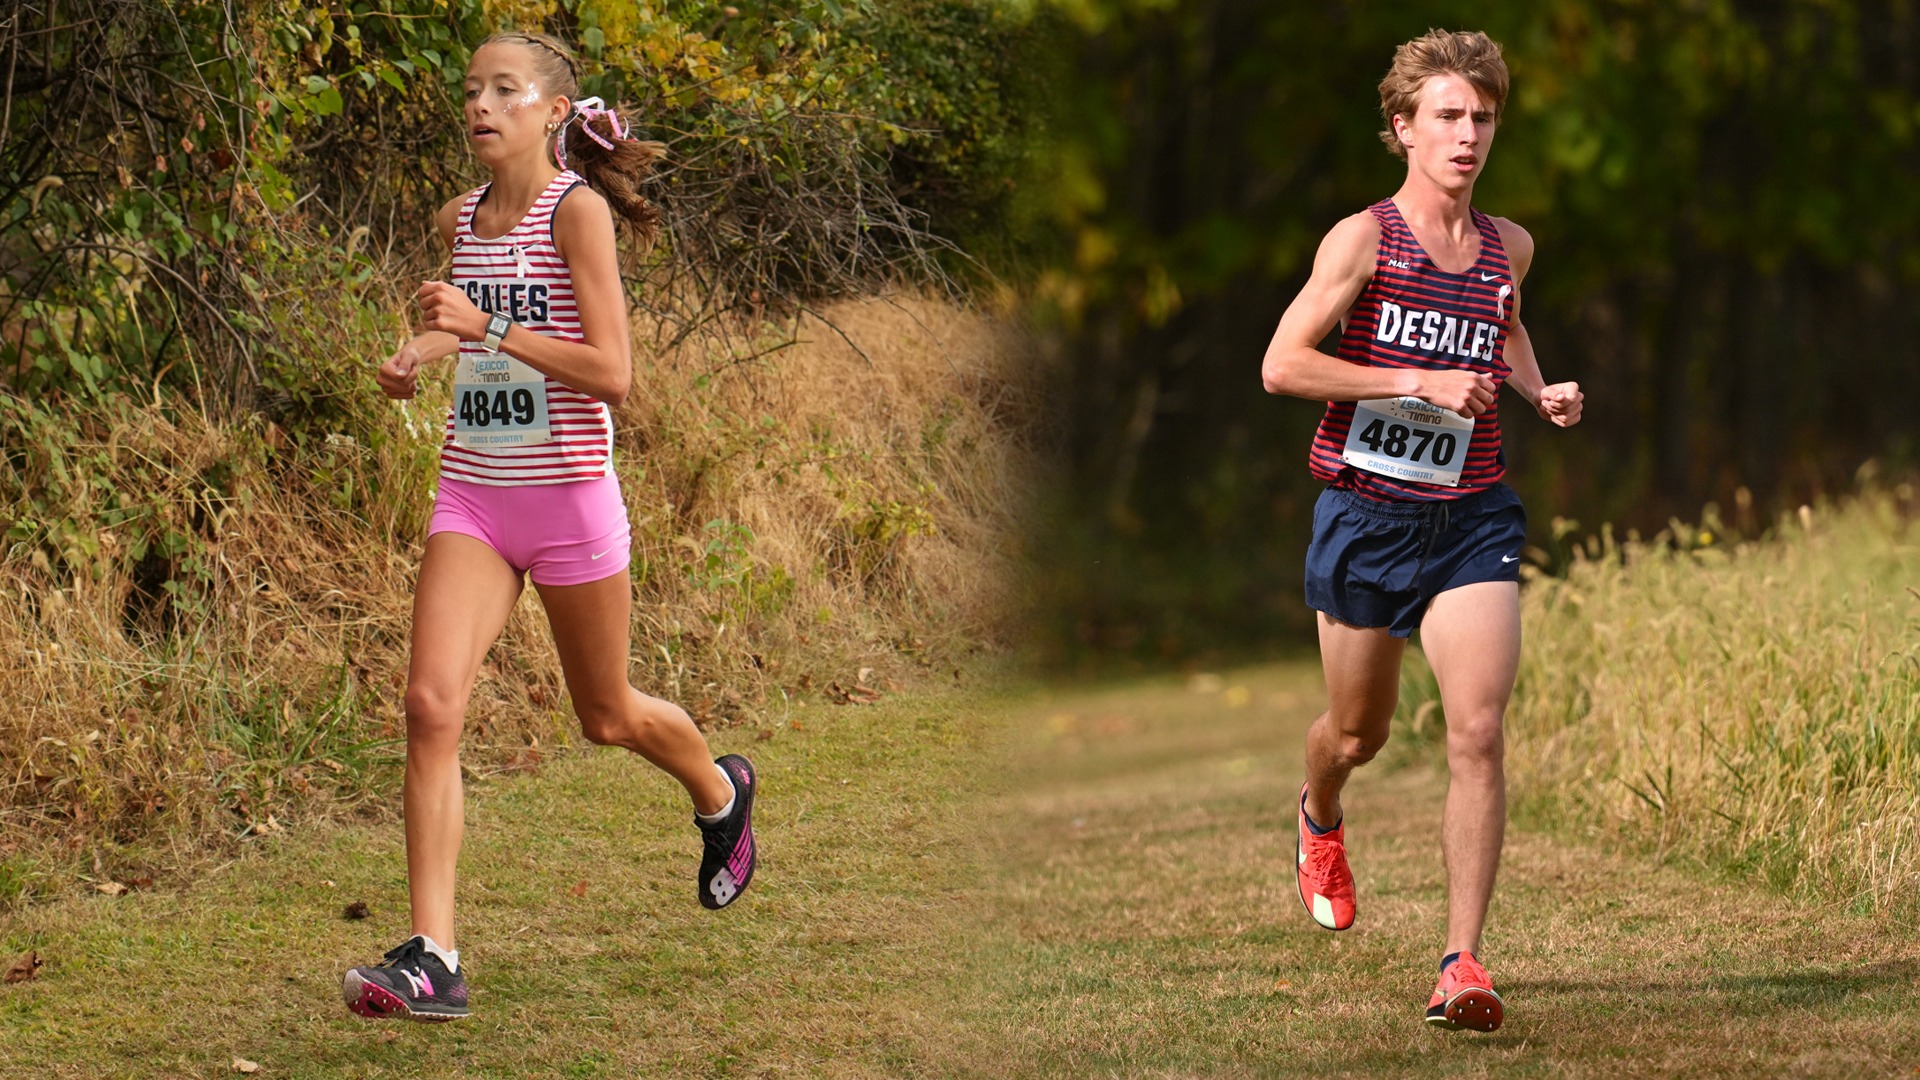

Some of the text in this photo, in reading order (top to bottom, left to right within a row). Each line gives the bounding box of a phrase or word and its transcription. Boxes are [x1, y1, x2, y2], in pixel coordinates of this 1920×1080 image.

[1388, 259, 1410, 269] MAC
[450, 281, 548, 322] SALES
[460, 389, 535, 427] 4849
[469, 434, 524, 444] CROSS COUNTRY
[1359, 418, 1457, 466] 4870
[1367, 459, 1435, 480] CROSS COUNTRY
